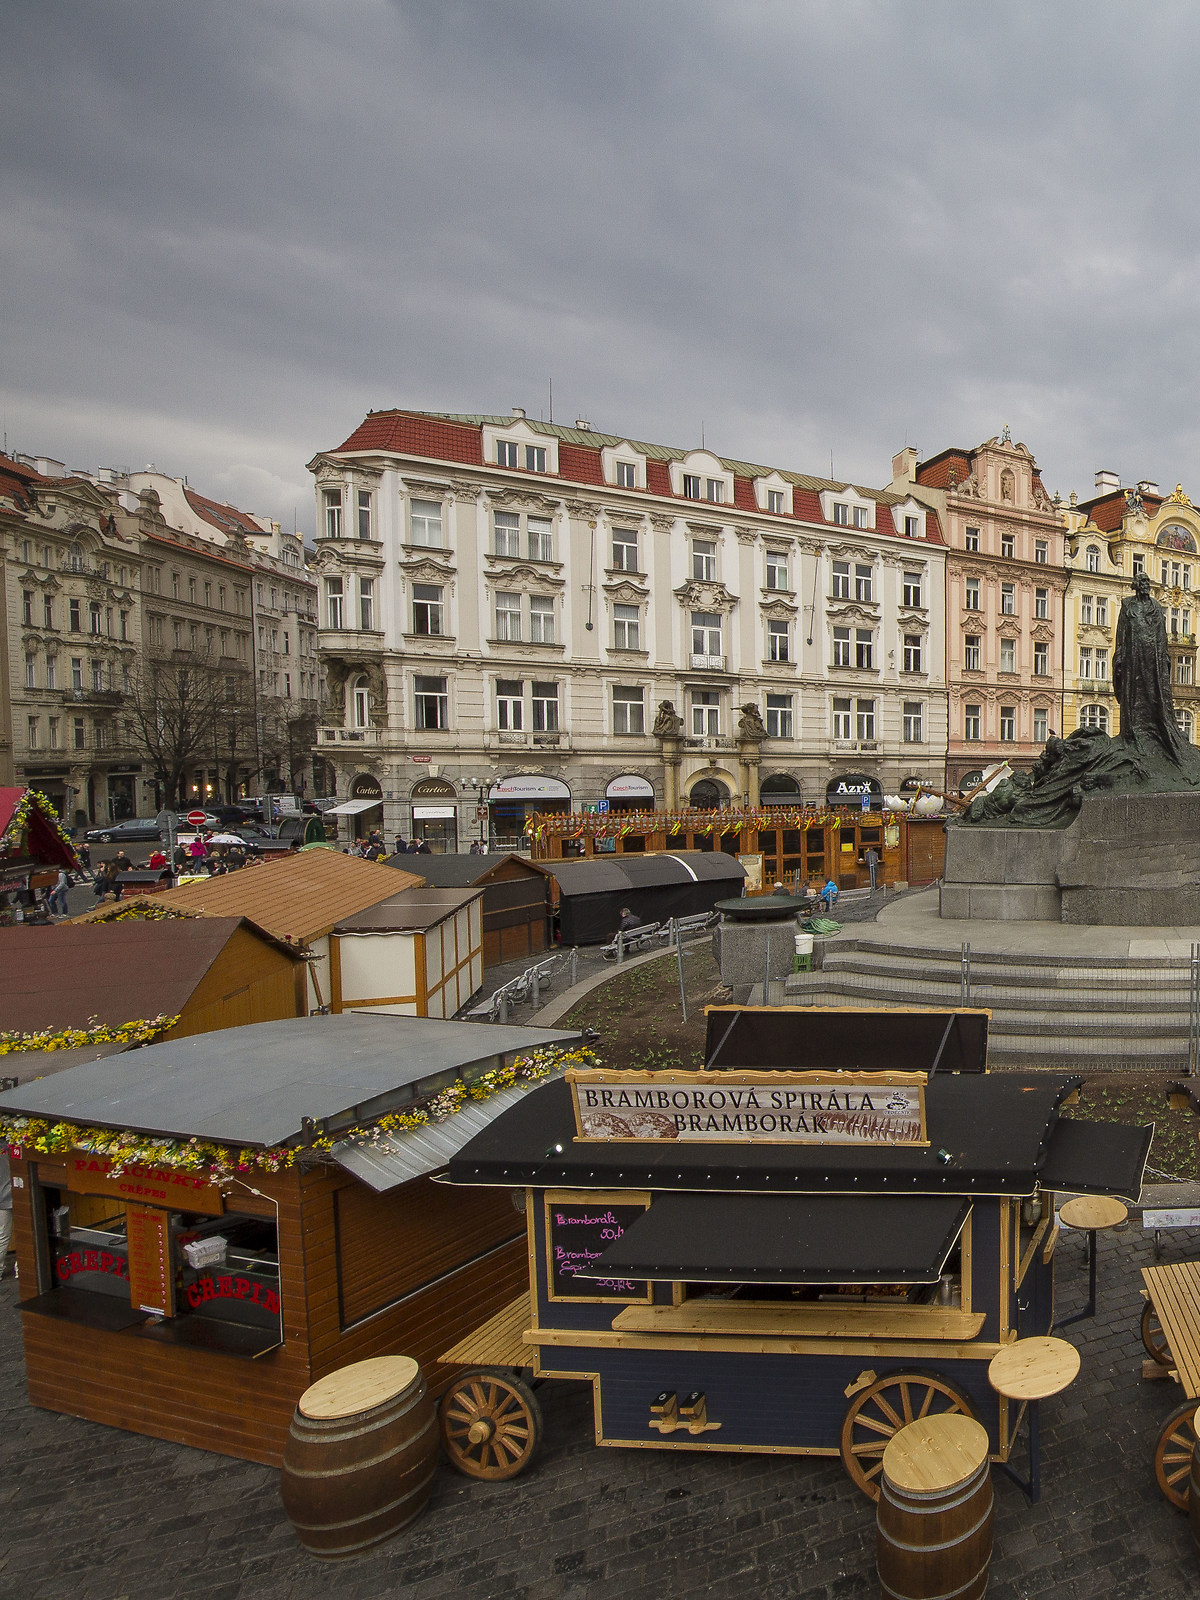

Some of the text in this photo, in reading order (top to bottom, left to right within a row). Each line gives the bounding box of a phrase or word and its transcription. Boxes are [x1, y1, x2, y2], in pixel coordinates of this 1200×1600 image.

[356, 785, 380, 795] Cartier
[417, 785, 451, 793] Cartier
[599, 801, 608, 810] P
[584, 1087, 876, 1112] BRAMBOROVÁ SPIRÁLA
[673, 1108, 829, 1135] BRAMBORÁK
[555, 1211, 618, 1226] Bramborák
[56, 1250, 131, 1281] CREPI
